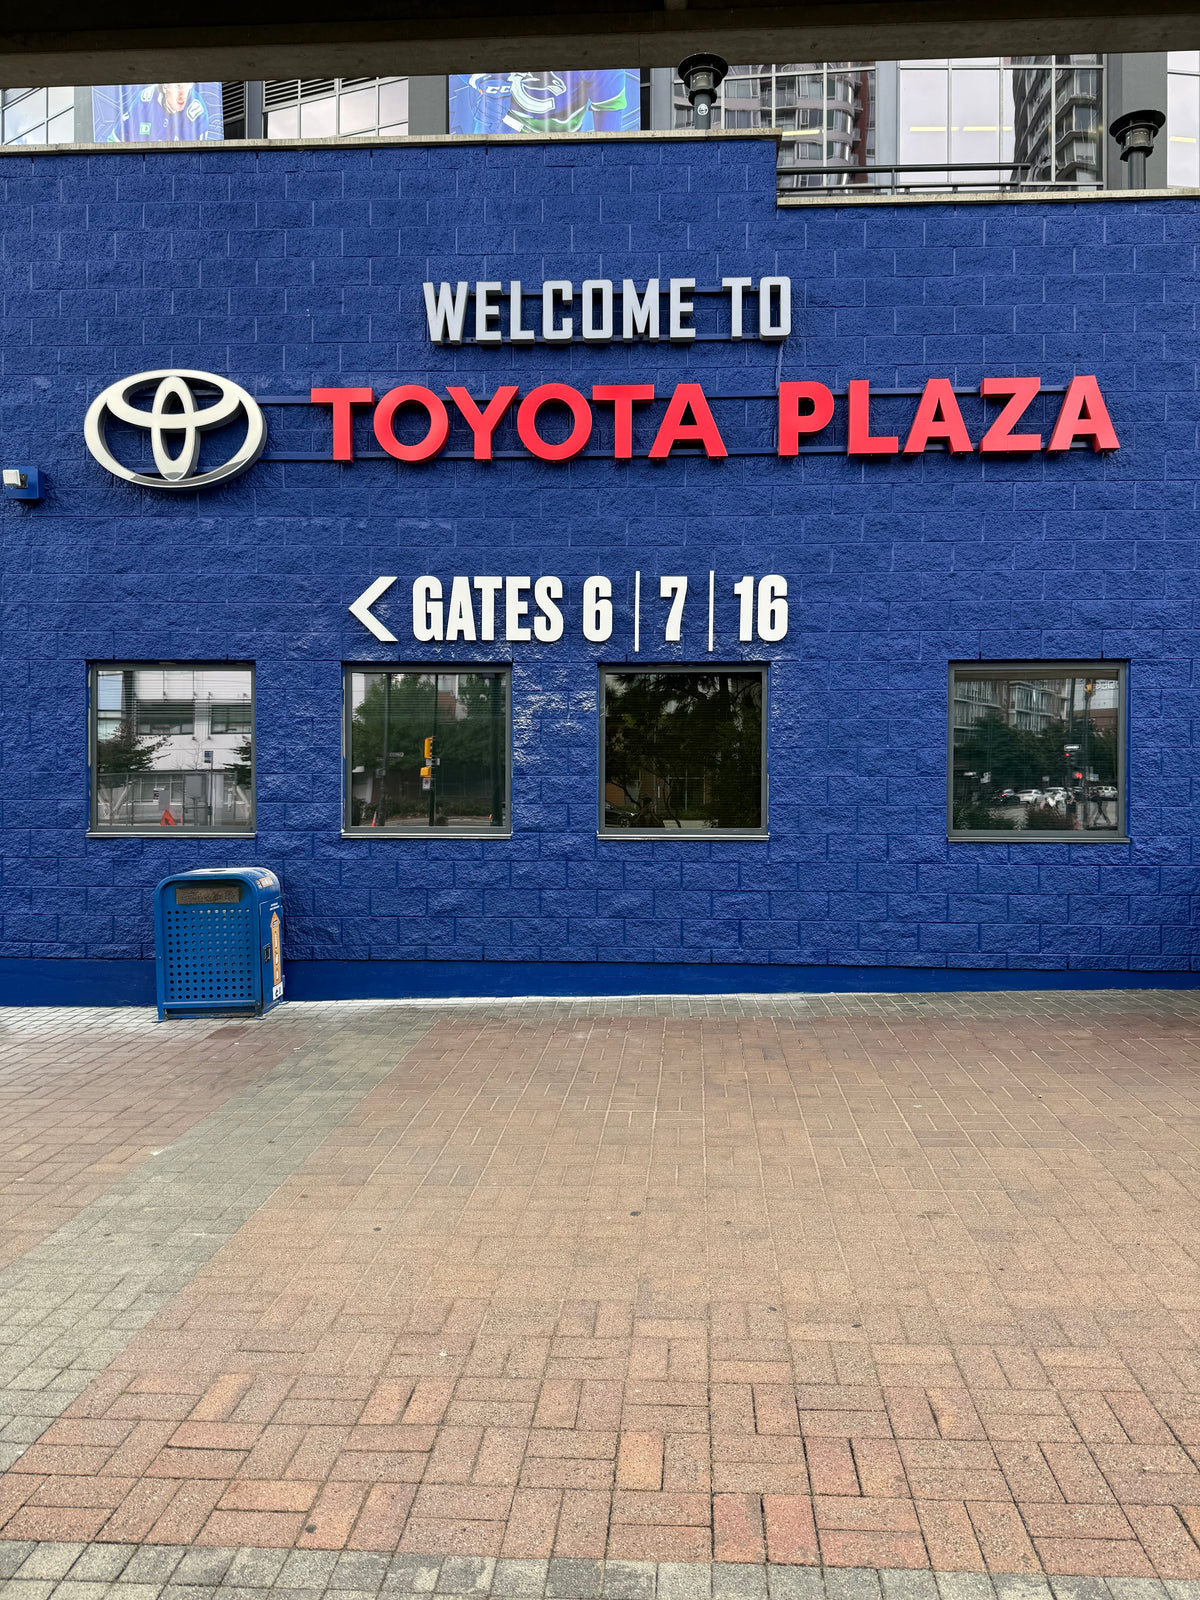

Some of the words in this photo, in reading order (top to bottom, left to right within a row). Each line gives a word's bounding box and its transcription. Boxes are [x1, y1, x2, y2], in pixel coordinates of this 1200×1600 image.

[422, 278, 696, 342] WELCOME
[721, 276, 792, 338] TO
[310, 383, 729, 462] TOYOTA
[778, 375, 1120, 456] PLAZA
[412, 575, 564, 642] GATES
[582, 575, 613, 642] 6
[660, 575, 688, 642] 7
[733, 574, 789, 642] 16
